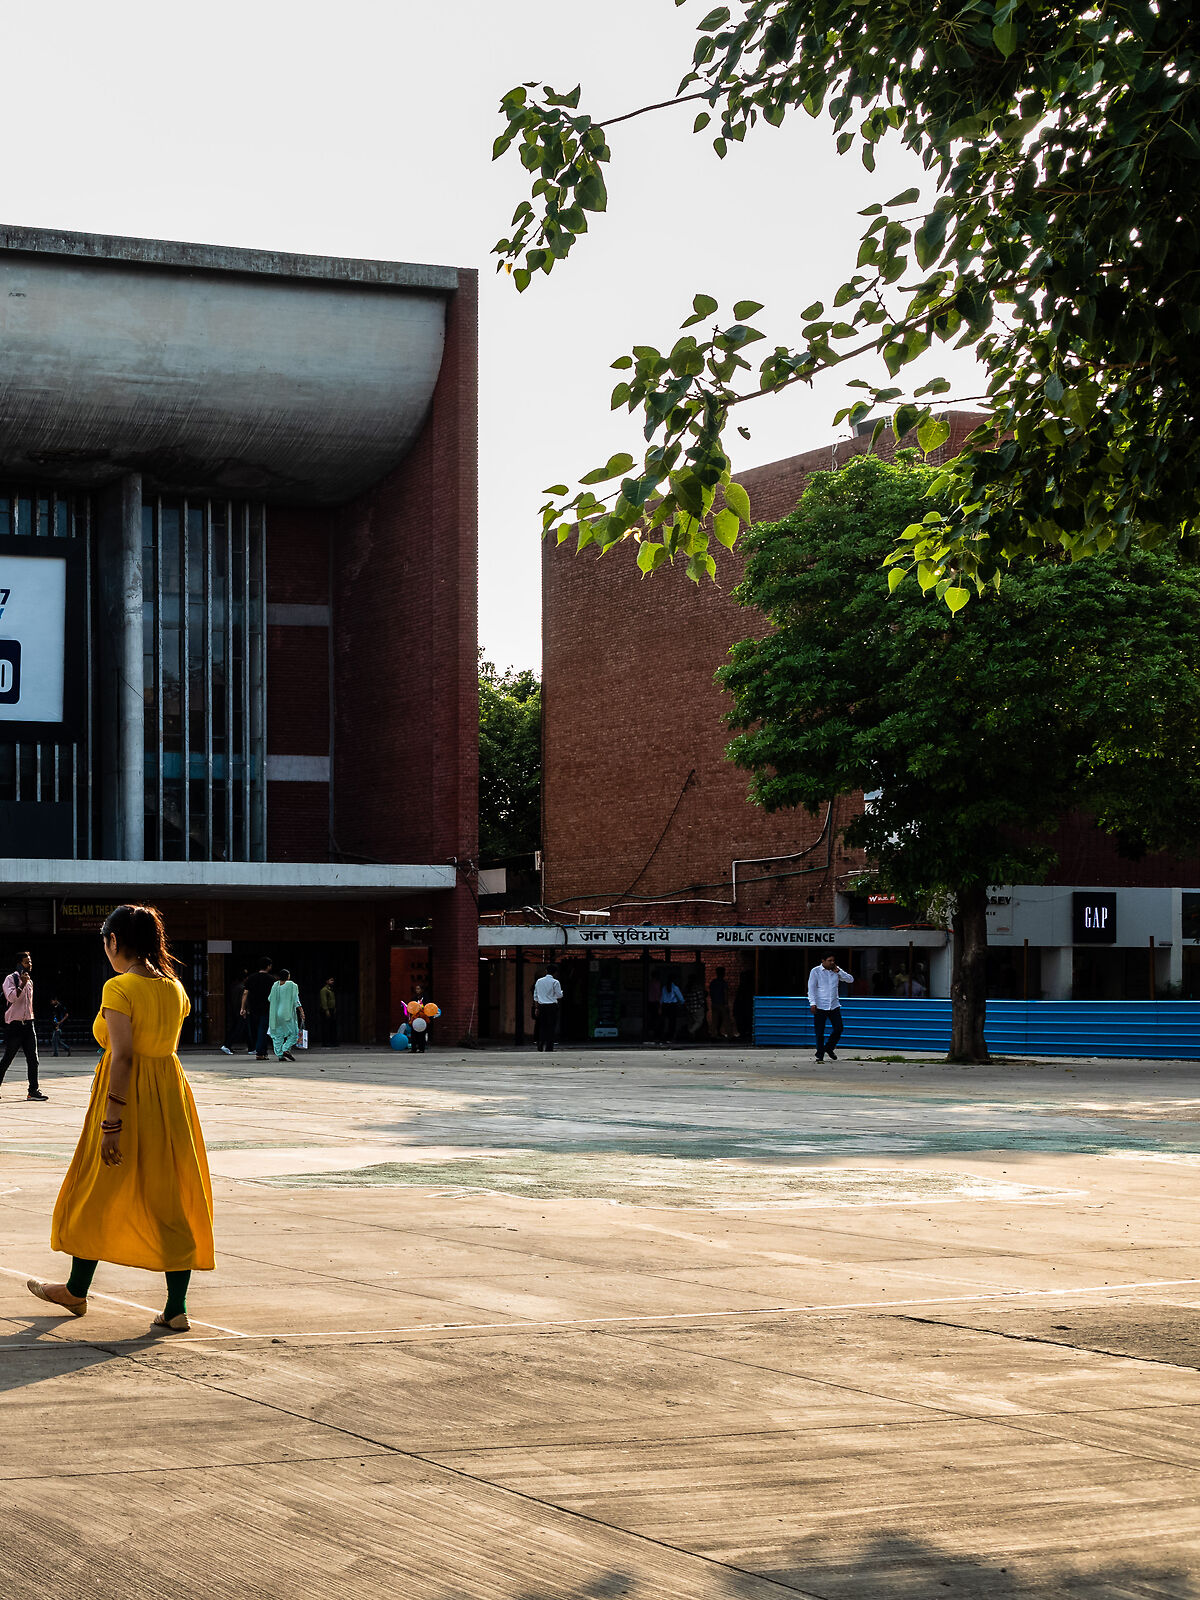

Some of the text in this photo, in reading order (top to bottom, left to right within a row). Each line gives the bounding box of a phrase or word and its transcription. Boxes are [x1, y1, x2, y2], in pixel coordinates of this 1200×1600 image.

[62, 904, 94, 916] NEELAM
[1084, 906, 1108, 929] GAP
[579, 928, 606, 941] जन
[716, 931, 835, 943] PUBLIC CONVENIENCE
